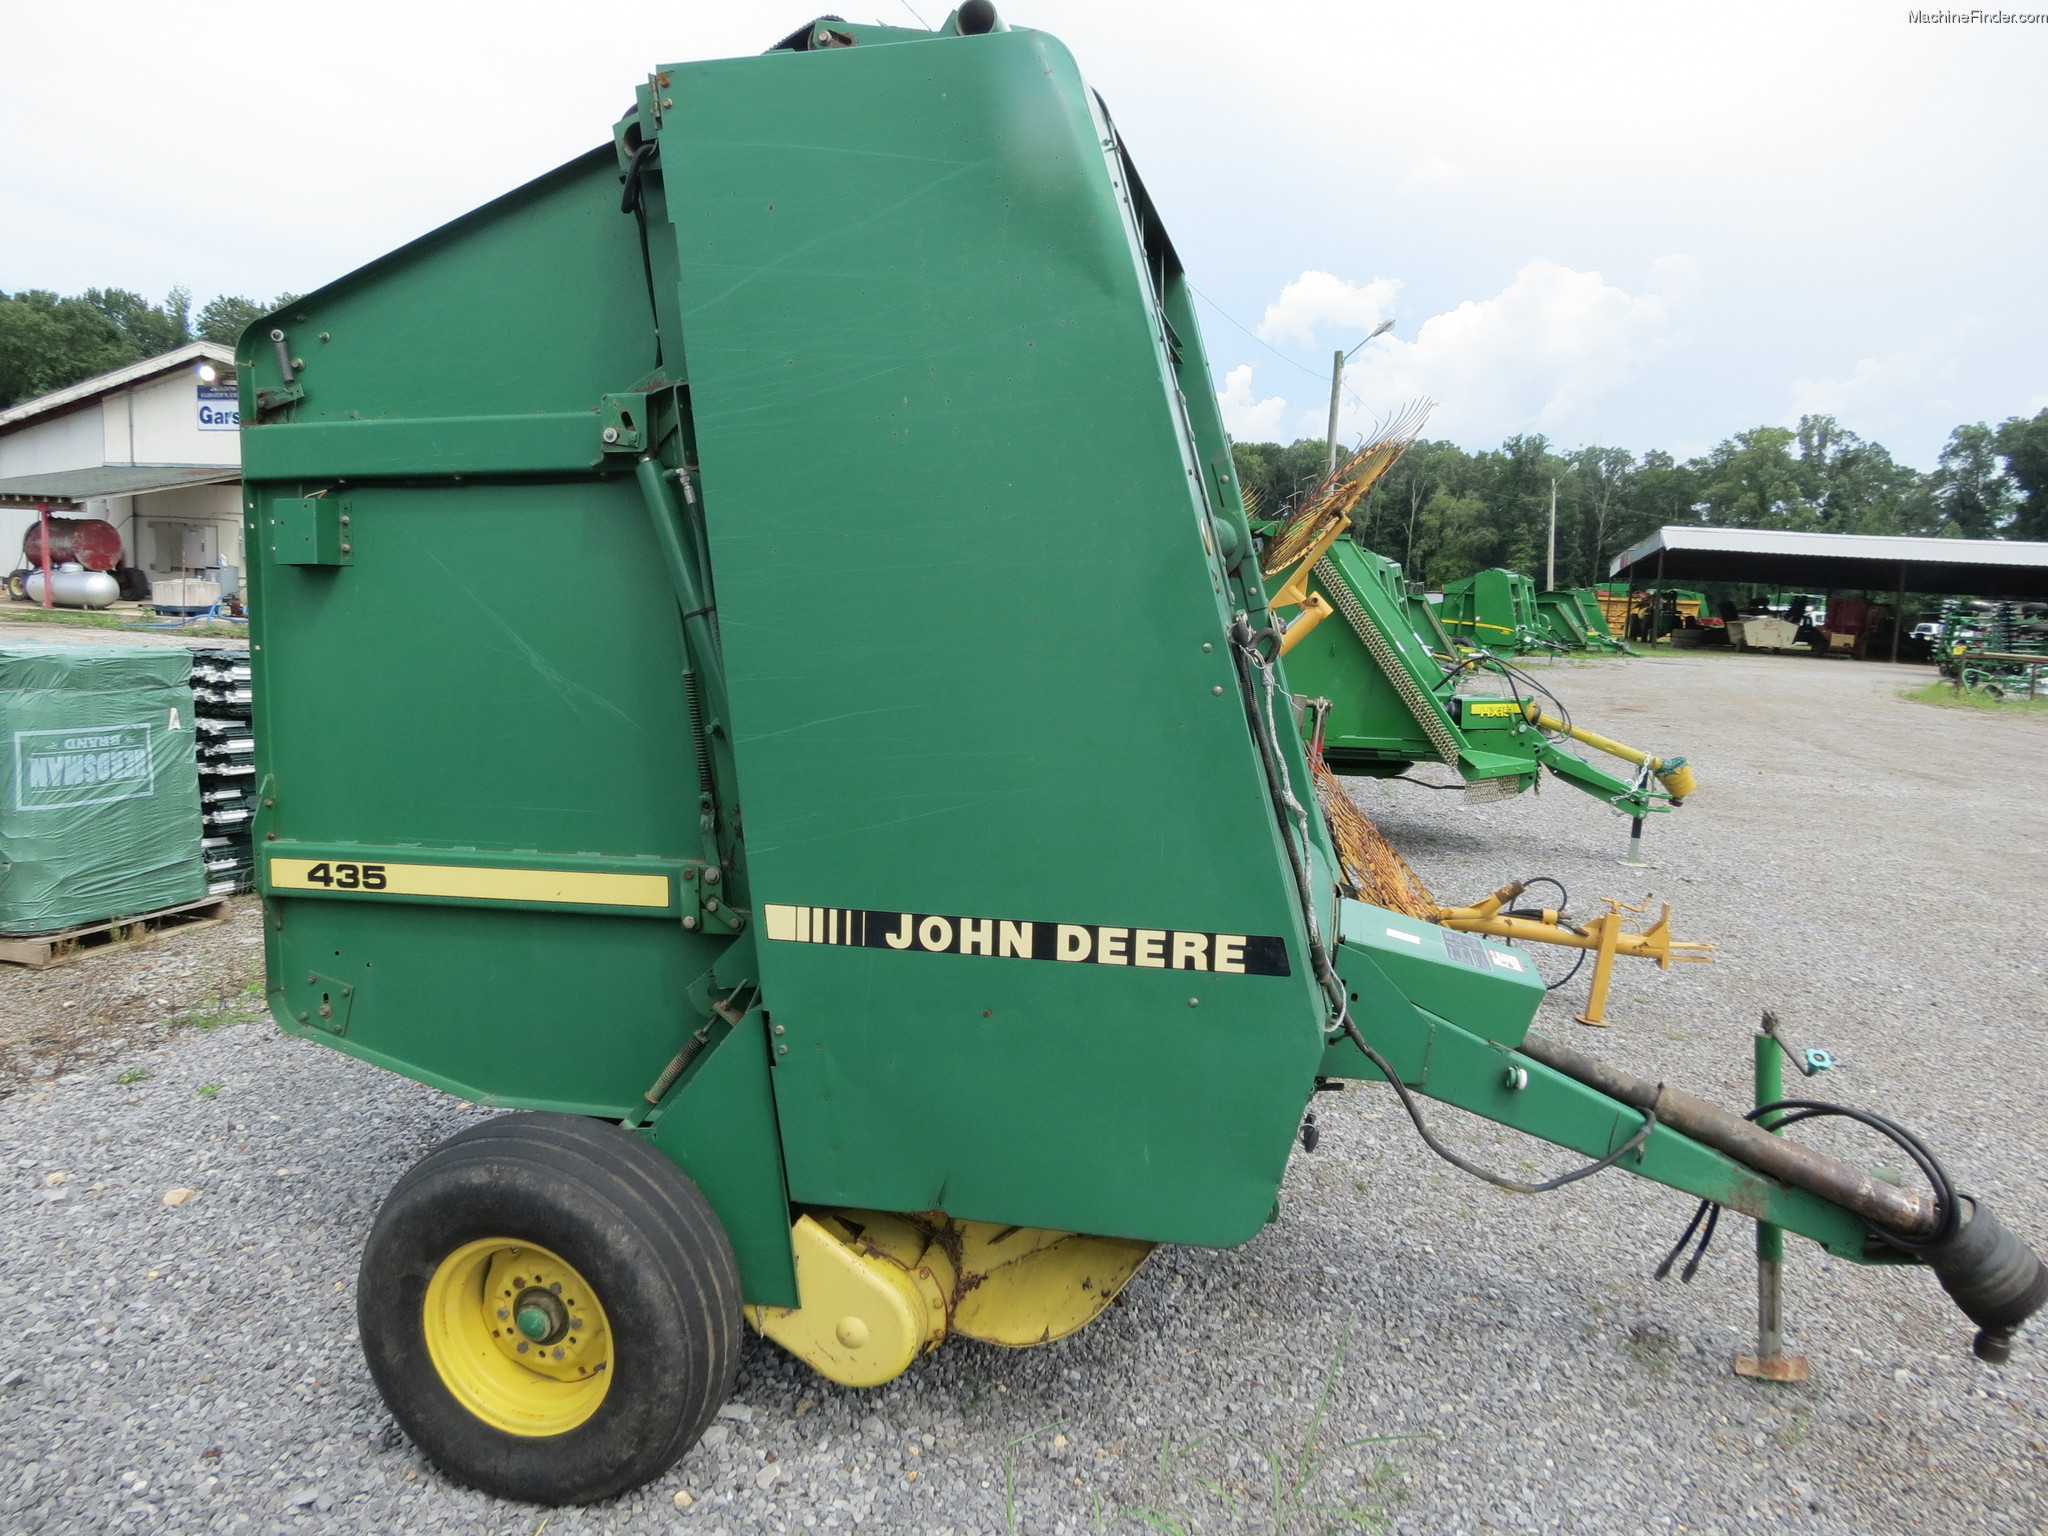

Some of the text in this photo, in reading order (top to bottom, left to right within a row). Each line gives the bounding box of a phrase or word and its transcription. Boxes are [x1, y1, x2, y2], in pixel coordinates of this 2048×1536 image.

[64, 735, 121, 750] BRAND
[307, 863, 387, 889] 435
[885, 913, 1247, 973] JOHN DEERE
